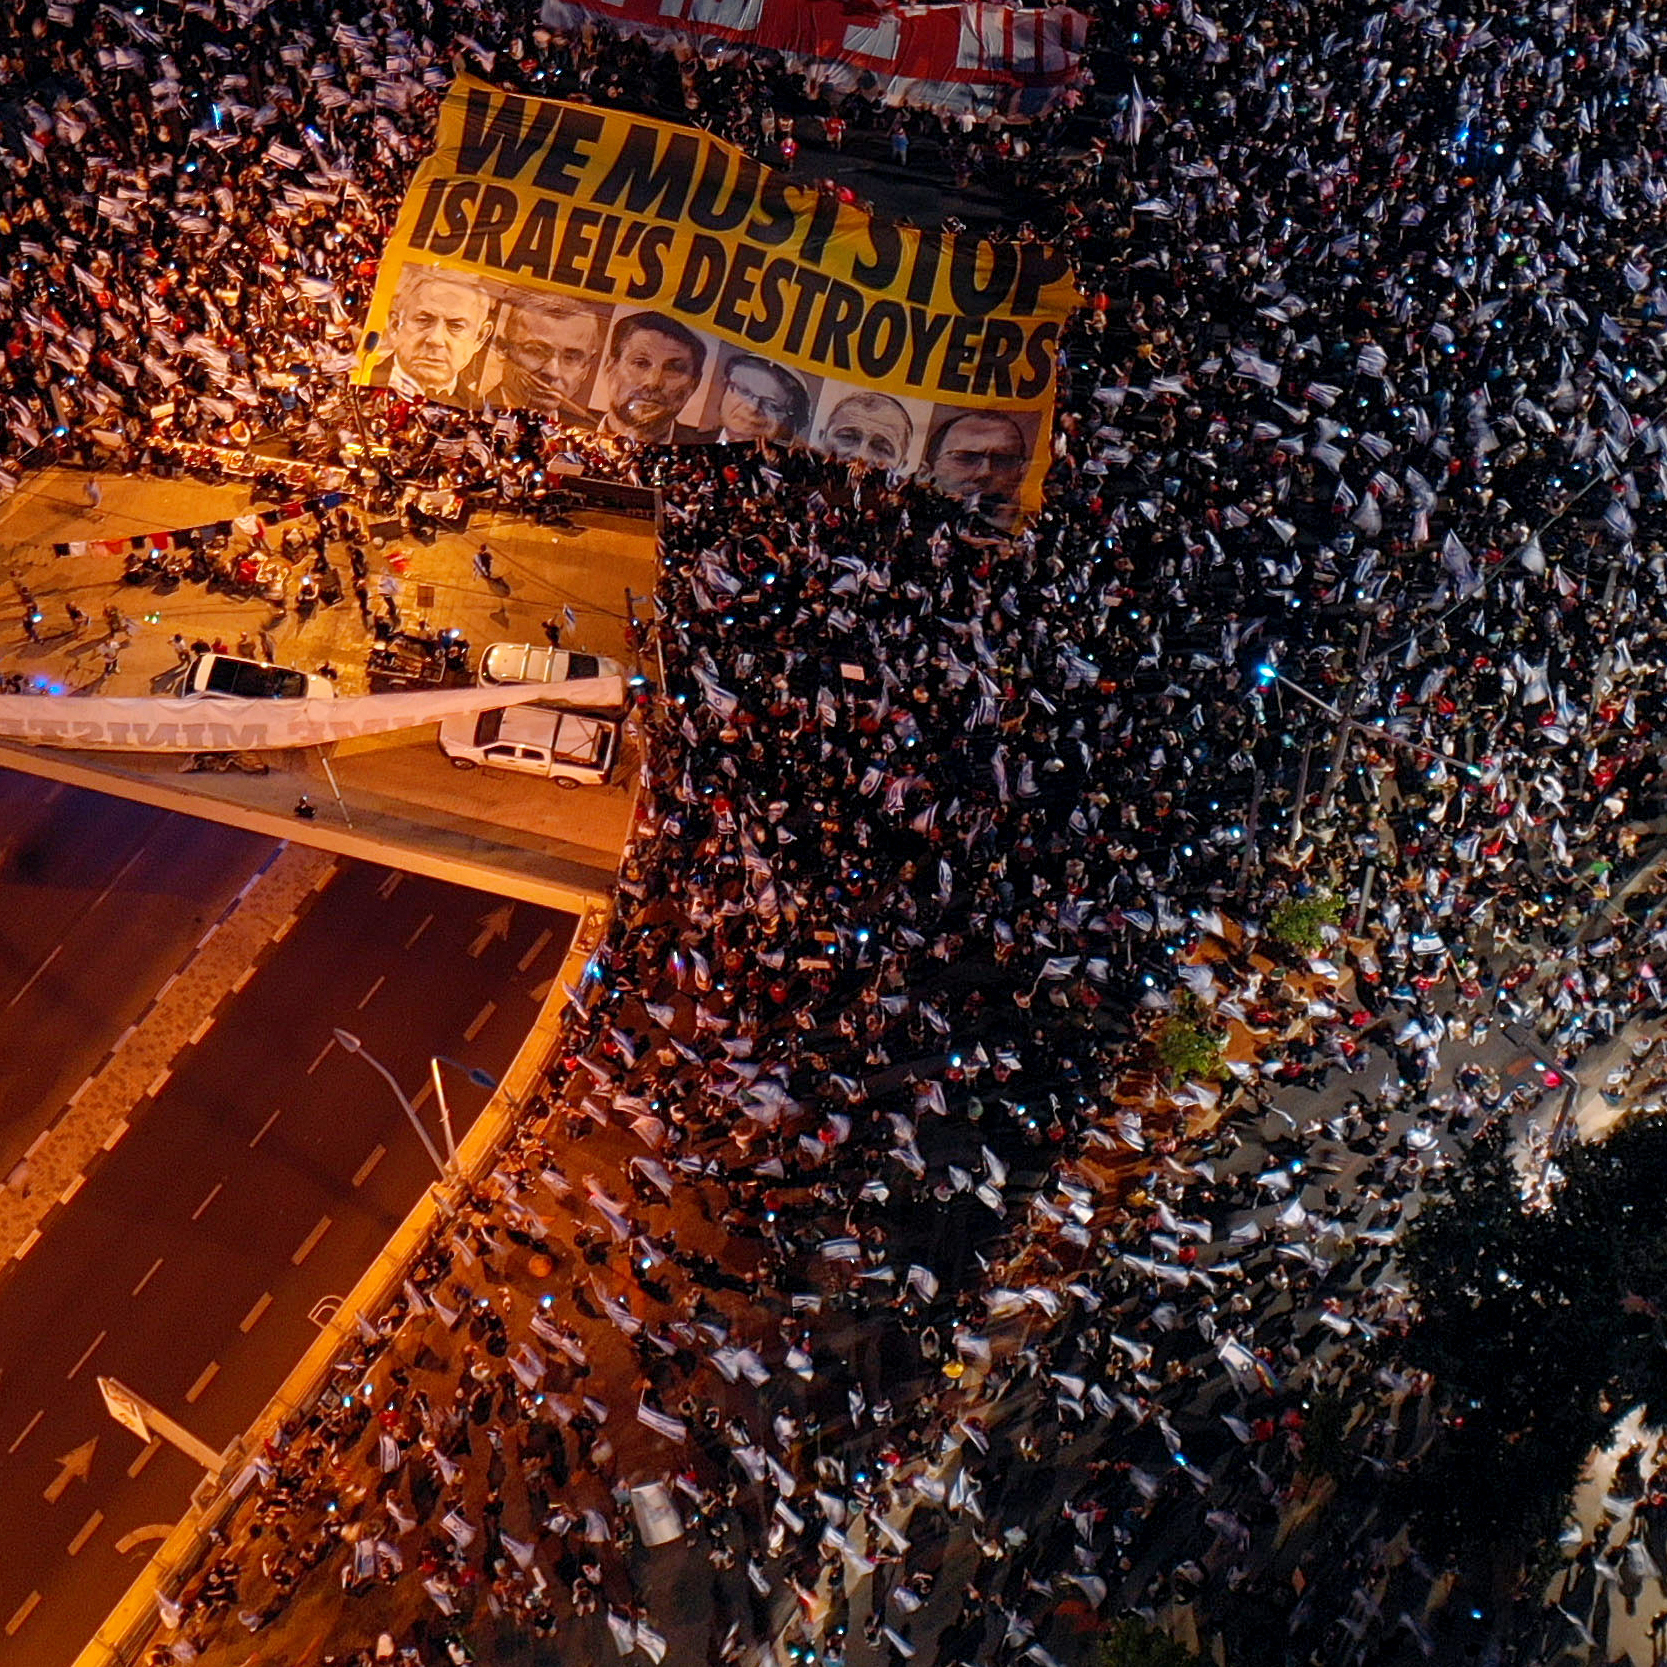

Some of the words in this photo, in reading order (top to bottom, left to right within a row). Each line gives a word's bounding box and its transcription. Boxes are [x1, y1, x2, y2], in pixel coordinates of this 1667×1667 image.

[456, 88, 606, 199] WE
[592, 123, 839, 268] MUST
[408, 177, 677, 300] ISRAEL'S
[673, 234, 1061, 400] DESTROYERS
